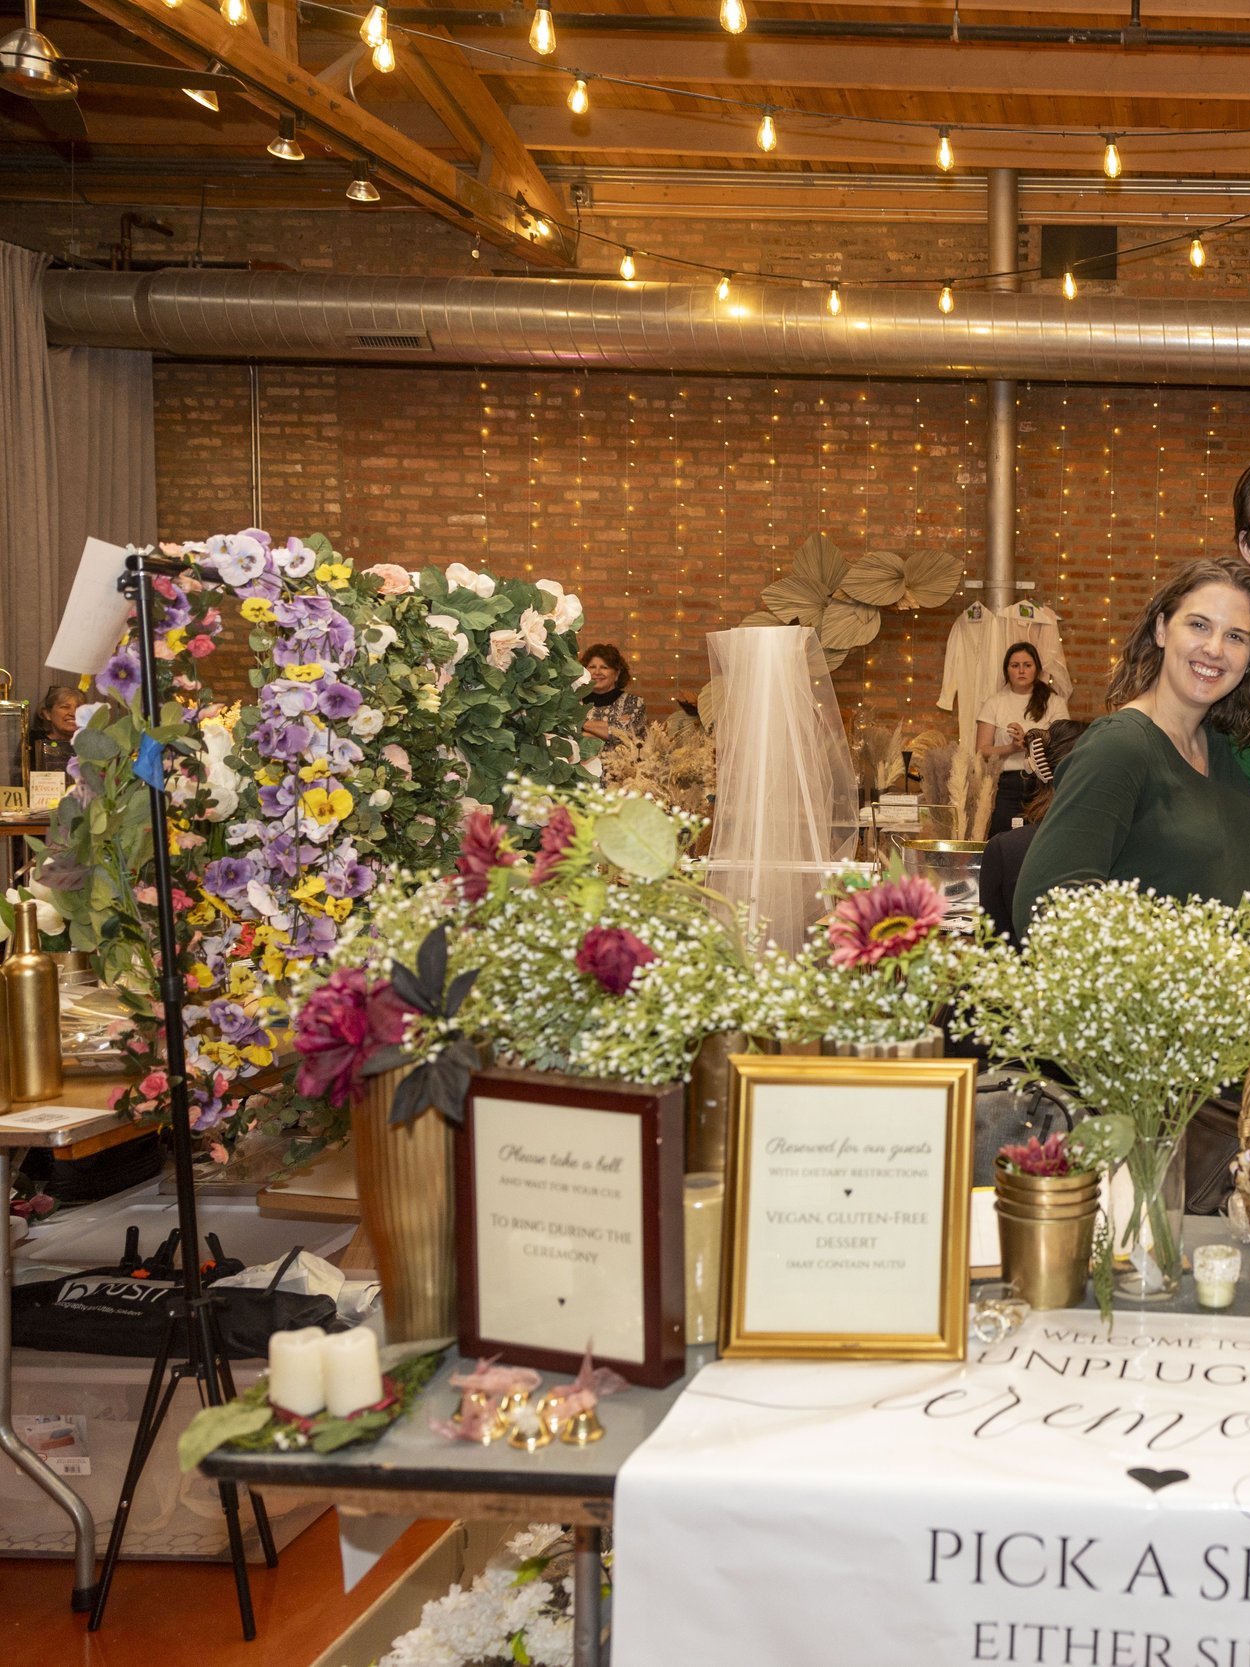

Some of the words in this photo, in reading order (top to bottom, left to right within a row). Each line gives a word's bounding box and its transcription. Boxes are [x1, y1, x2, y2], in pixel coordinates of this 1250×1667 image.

[498, 1143, 546, 1165] Please
[549, 1150, 578, 1169] take
[582, 1159, 592, 1170] a
[595, 1155, 624, 1173] bell
[766, 1136, 836, 1155] Reserved
[837, 1137, 858, 1158] for
[864, 1144, 886, 1154] our
[888, 1141, 932, 1162] guests
[768, 1167, 798, 1178] WITH
[801, 1167, 846, 1178] DIETARY
[850, 1167, 929, 1178] RESTRICTIONS
[490, 1213, 509, 1228] TO
[511, 1217, 546, 1232] RING
[548, 1221, 603, 1241] DURING
[606, 1228, 633, 1245] THE
[826, 1210, 929, 1225] GLUTEN-FREE
[522, 1243, 599, 1265] CEREMONY
[815, 1236, 878, 1249] DESSERT
[816, 1259, 870, 1270] CONTAIN
[1042, 1328, 1201, 1351] WELCOME
[924, 1527, 1101, 1593] PICK
[1122, 1542, 1177, 1598] A
[972, 1620, 1173, 1667] EITHER
